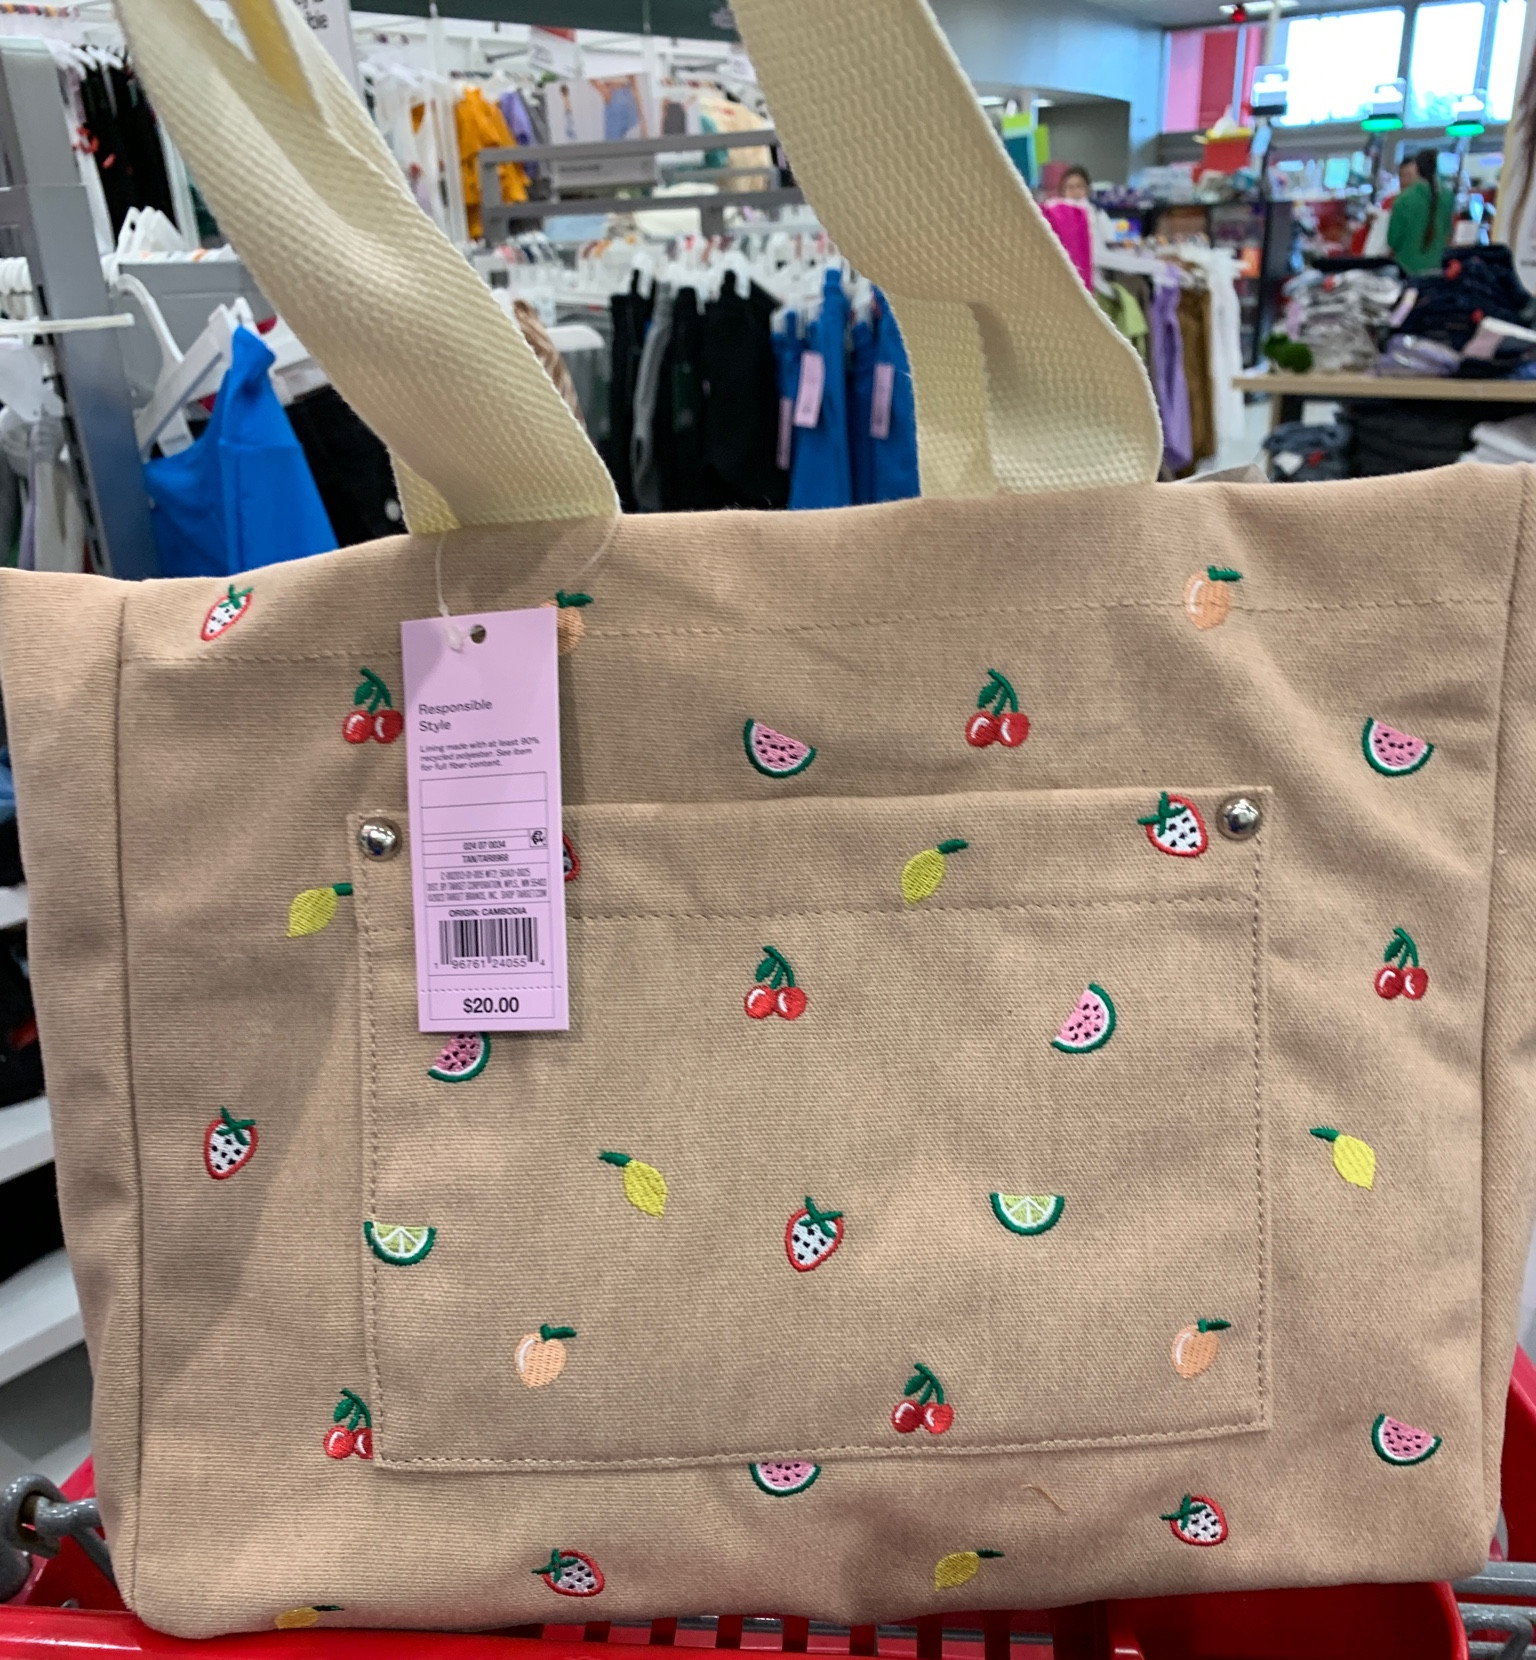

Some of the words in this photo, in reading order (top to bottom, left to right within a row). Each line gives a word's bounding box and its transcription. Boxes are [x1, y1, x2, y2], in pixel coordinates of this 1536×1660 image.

[419, 699, 493, 715] Responsible
[419, 719, 451, 733] Style
[420, 745, 444, 753] Lining
[446, 743, 467, 751] made
[469, 741, 487, 749] with
[488, 740, 497, 748] at
[498, 739, 518, 747] least
[496, 748, 511, 757] See
[448, 908, 480, 917] ORIGIN:
[481, 907, 527, 916] CAMBODIA
[452, 959, 486, 969] 96761
[491, 957, 527, 968] 24055
[462, 996, 520, 1014] $20.00
